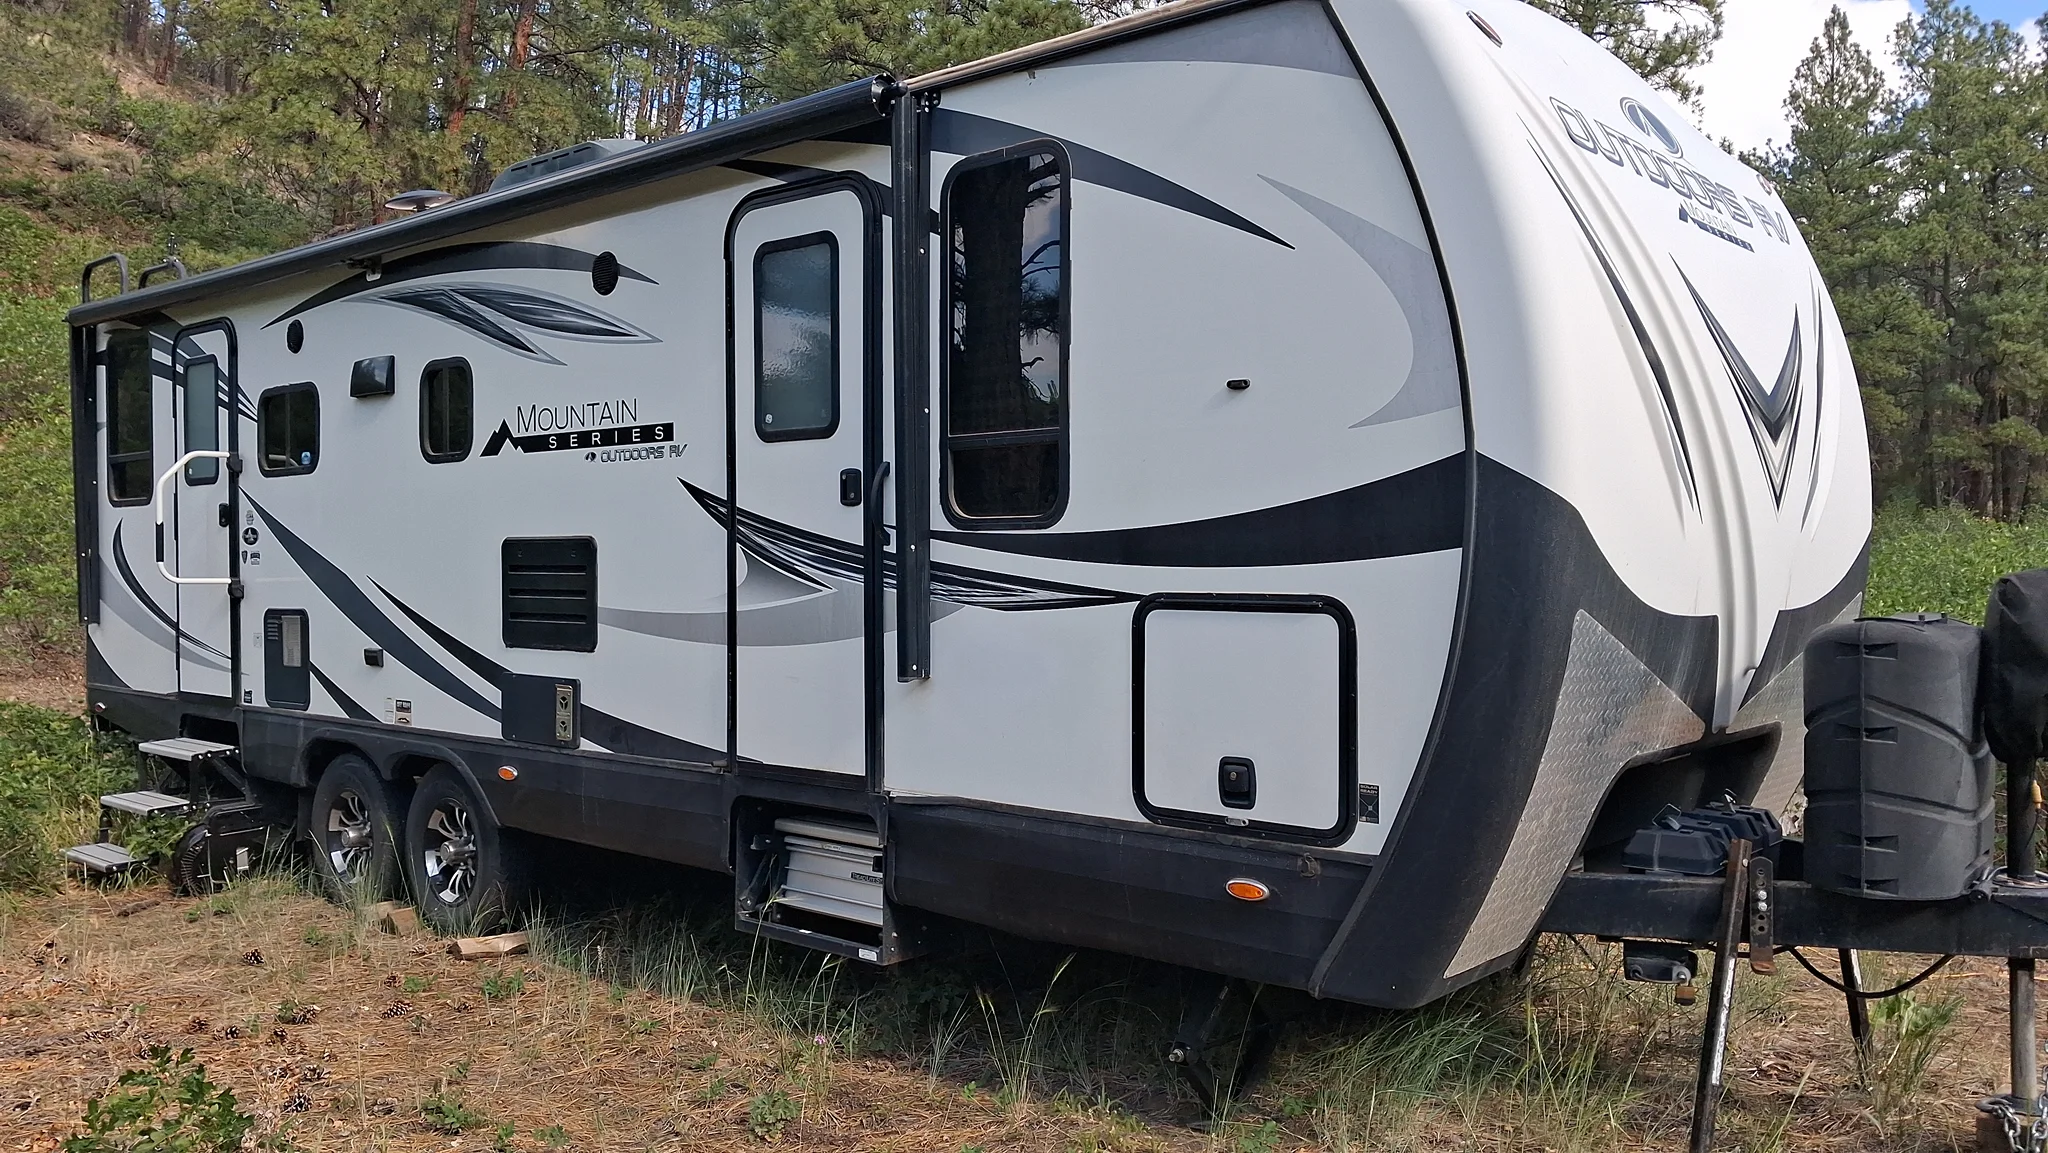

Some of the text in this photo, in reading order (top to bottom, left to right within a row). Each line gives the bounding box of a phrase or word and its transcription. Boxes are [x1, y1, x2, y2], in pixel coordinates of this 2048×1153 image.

[1549, 96, 1790, 245] OUTDOORS RV
[1682, 199, 1737, 236] MOUNTAIN
[1706, 224, 1752, 250] SERIES
[516, 397, 638, 433] MOUNTAIN
[549, 426, 664, 448] SERIES
[600, 443, 688, 463] OUTDOORS RV
